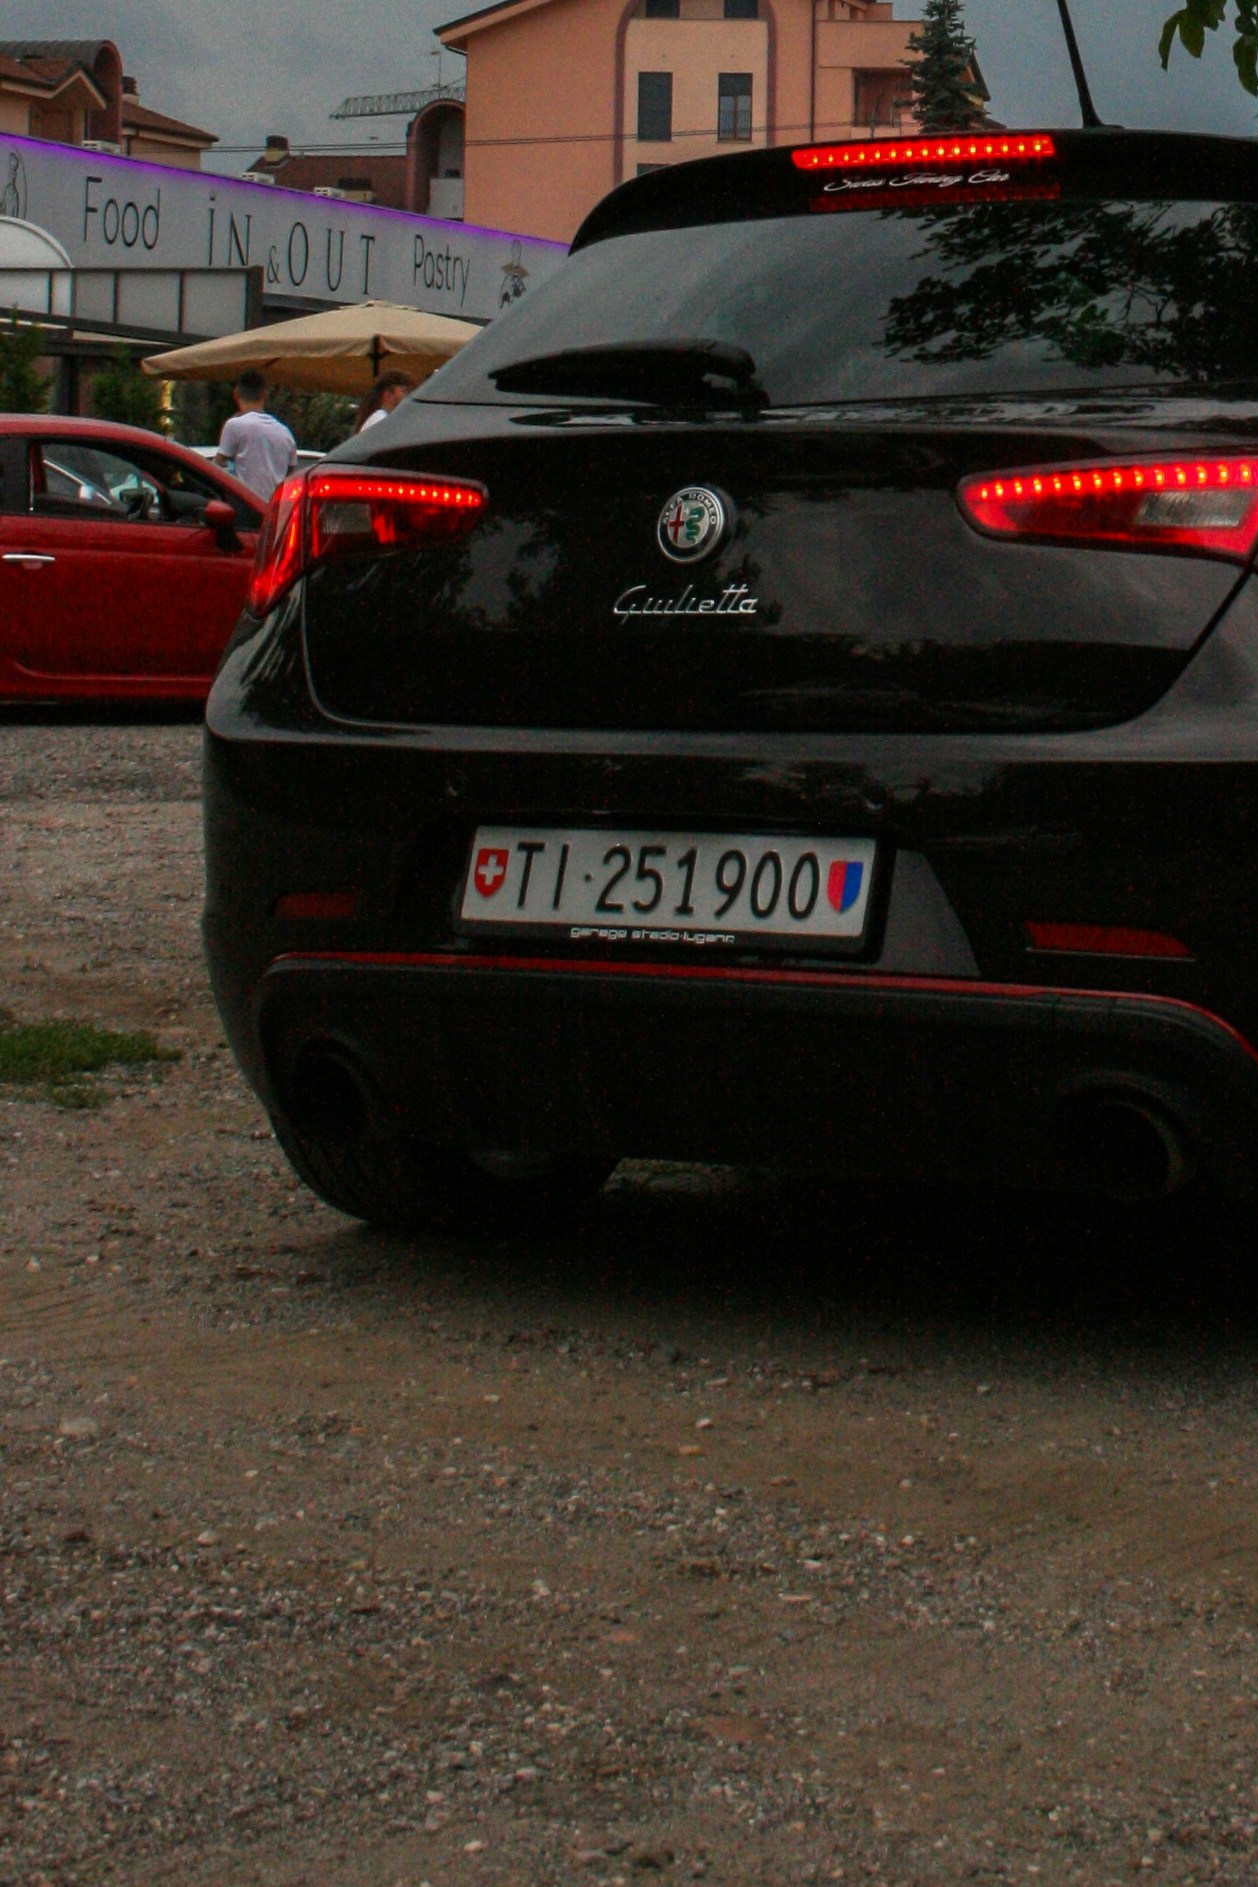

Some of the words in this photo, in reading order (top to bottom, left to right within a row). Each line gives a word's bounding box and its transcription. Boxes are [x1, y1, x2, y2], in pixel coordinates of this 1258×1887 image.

[84, 175, 161, 250] Food
[266, 245, 281, 284] &
[288, 221, 375, 295] OUT
[413, 234, 471, 308] Pastry
[687, 492, 718, 525] ROMEO
[613, 583, 758, 625] Giulietta
[570, 926, 628, 940] garage
